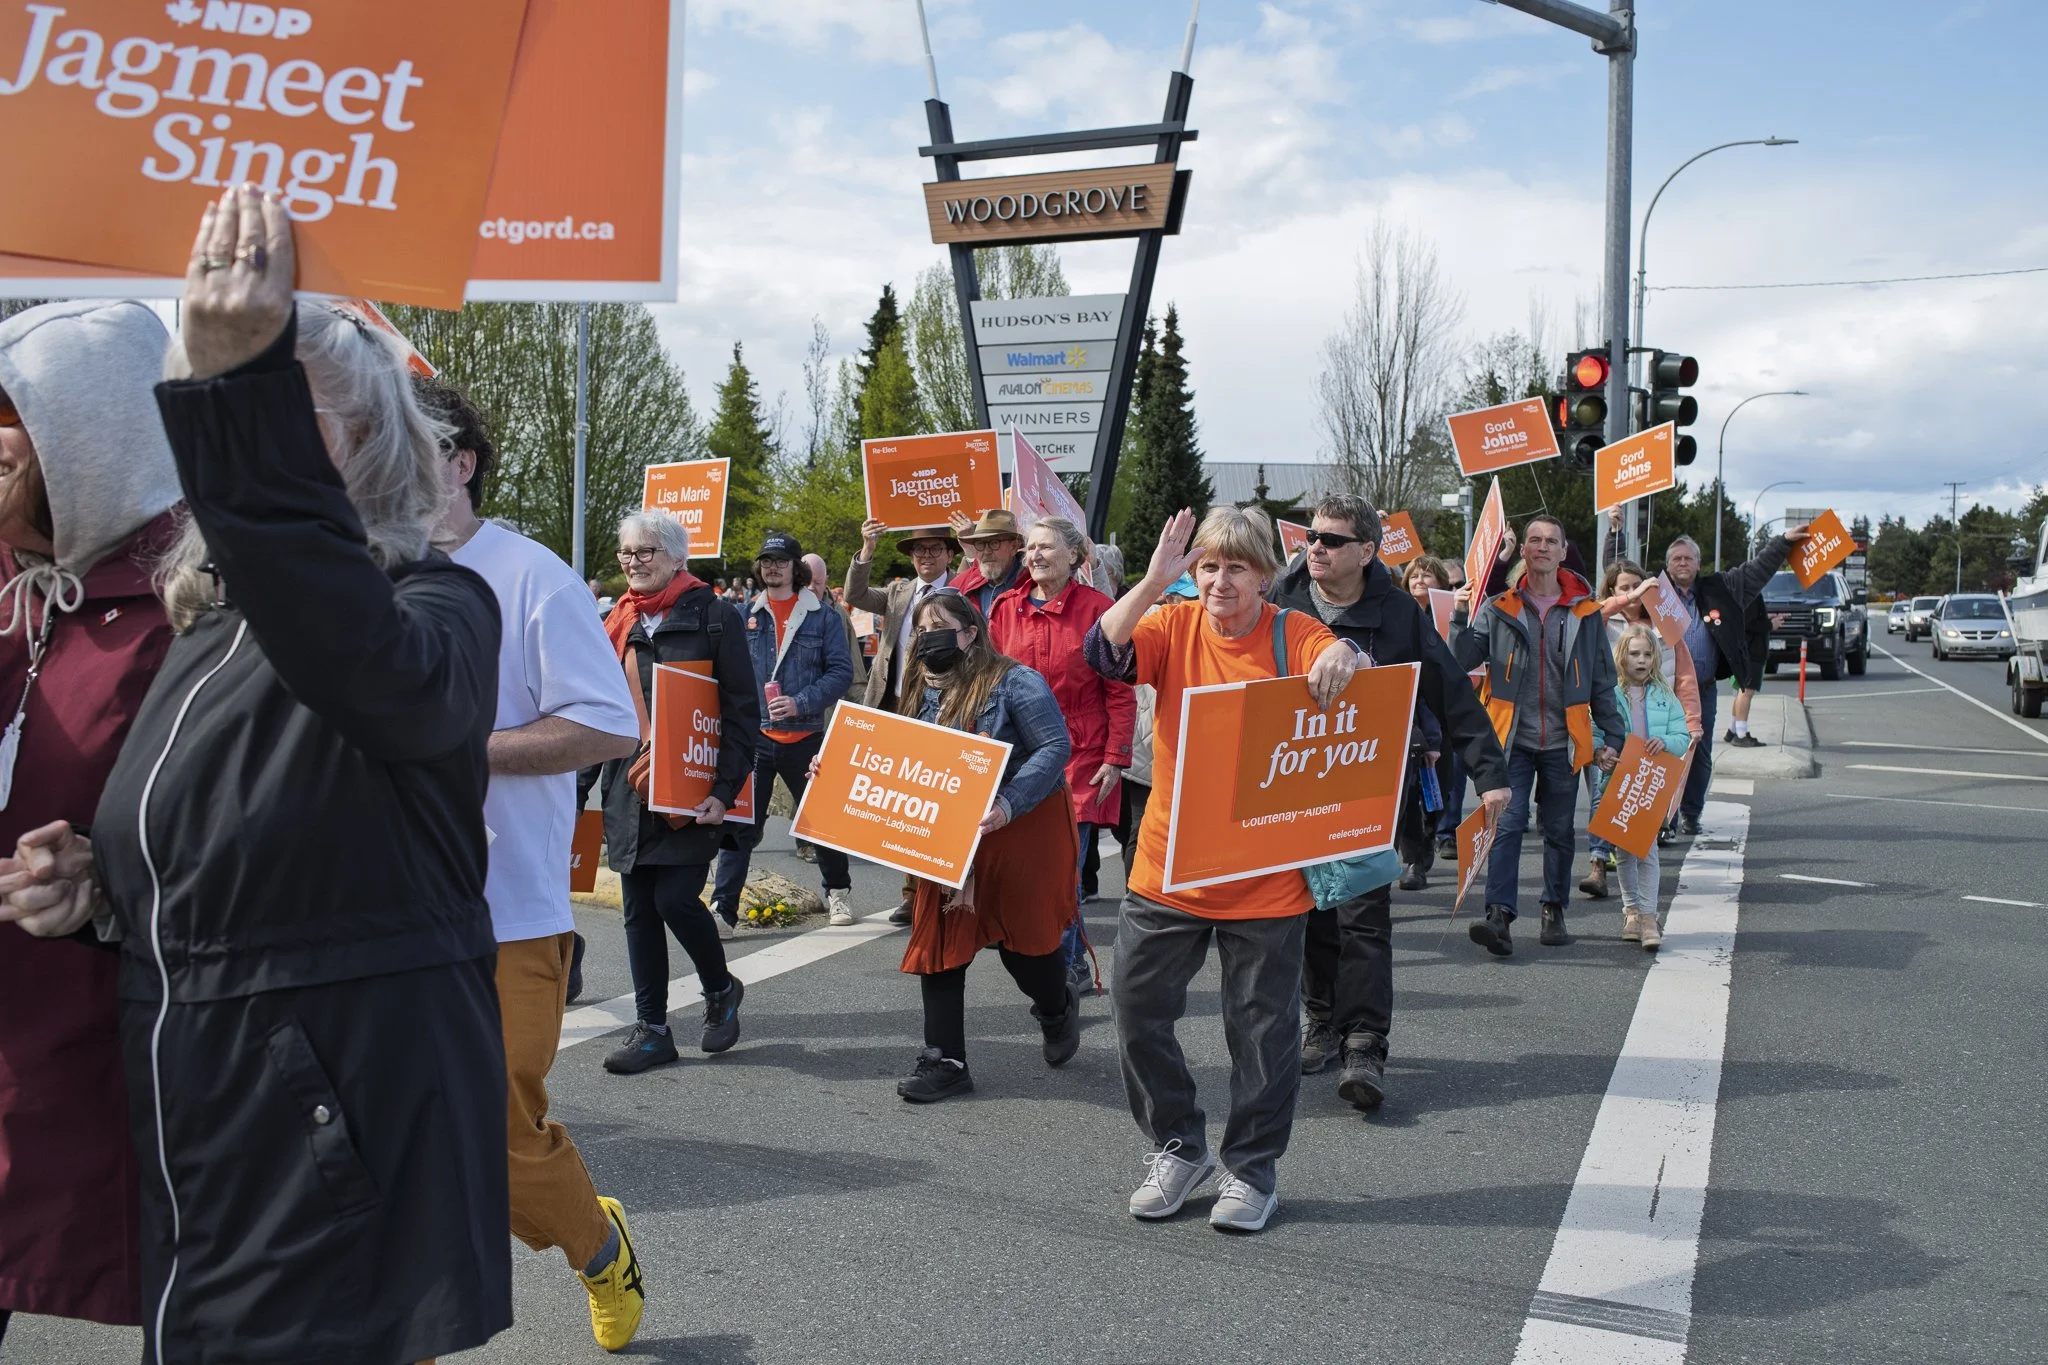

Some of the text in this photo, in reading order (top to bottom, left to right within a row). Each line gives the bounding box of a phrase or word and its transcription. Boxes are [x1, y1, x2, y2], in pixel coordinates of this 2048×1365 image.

[201, 1, 312, 39] NDP
[0, 4, 423, 132] Jagmeet
[142, 112, 399, 222] Singh
[944, 184, 1147, 224] WOODGROVE
[480, 216, 615, 244] ctgord.ca
[981, 310, 1113, 328] HUDSON'S BAY
[1007, 350, 1066, 368] Walmart
[998, 381, 1094, 396] AVALON CINEMAS
[1001, 411, 1091, 426] WINNERS
[1484, 418, 1515, 434] Gord
[872, 446, 898, 454] Re-Elect
[1035, 443, 1076, 455] RTCHEK
[1481, 431, 1528, 450] Johns
[1620, 447, 1645, 466] Gord
[1614, 461, 1652, 484] Johns
[657, 486, 710, 504] Lisa Marie
[890, 473, 959, 497] Jagmeet
[918, 489, 961, 508] Singh
[1381, 527, 1408, 547] meet
[1382, 540, 1413, 555] Singh
[1801, 531, 1827, 557] In it
[1802, 554, 1820, 575] for
[1819, 535, 1841, 561] you
[844, 716, 876, 733] Re-Elect
[1291, 700, 1358, 741] In it
[682, 736, 720, 768] Joh
[958, 750, 992, 767] Jagmeet
[849, 744, 962, 794] Lisa Marie
[967, 762, 990, 774] Singh
[1259, 737, 1379, 789] for you
[848, 773, 939, 824] Barron
[1611, 757, 1653, 833] Jagmeet
[1639, 765, 1667, 811] Singh
[1328, 823, 1382, 841] reelectgord.ca
[881, 840, 954, 869] LisaMarieBarron.ndp.ca
